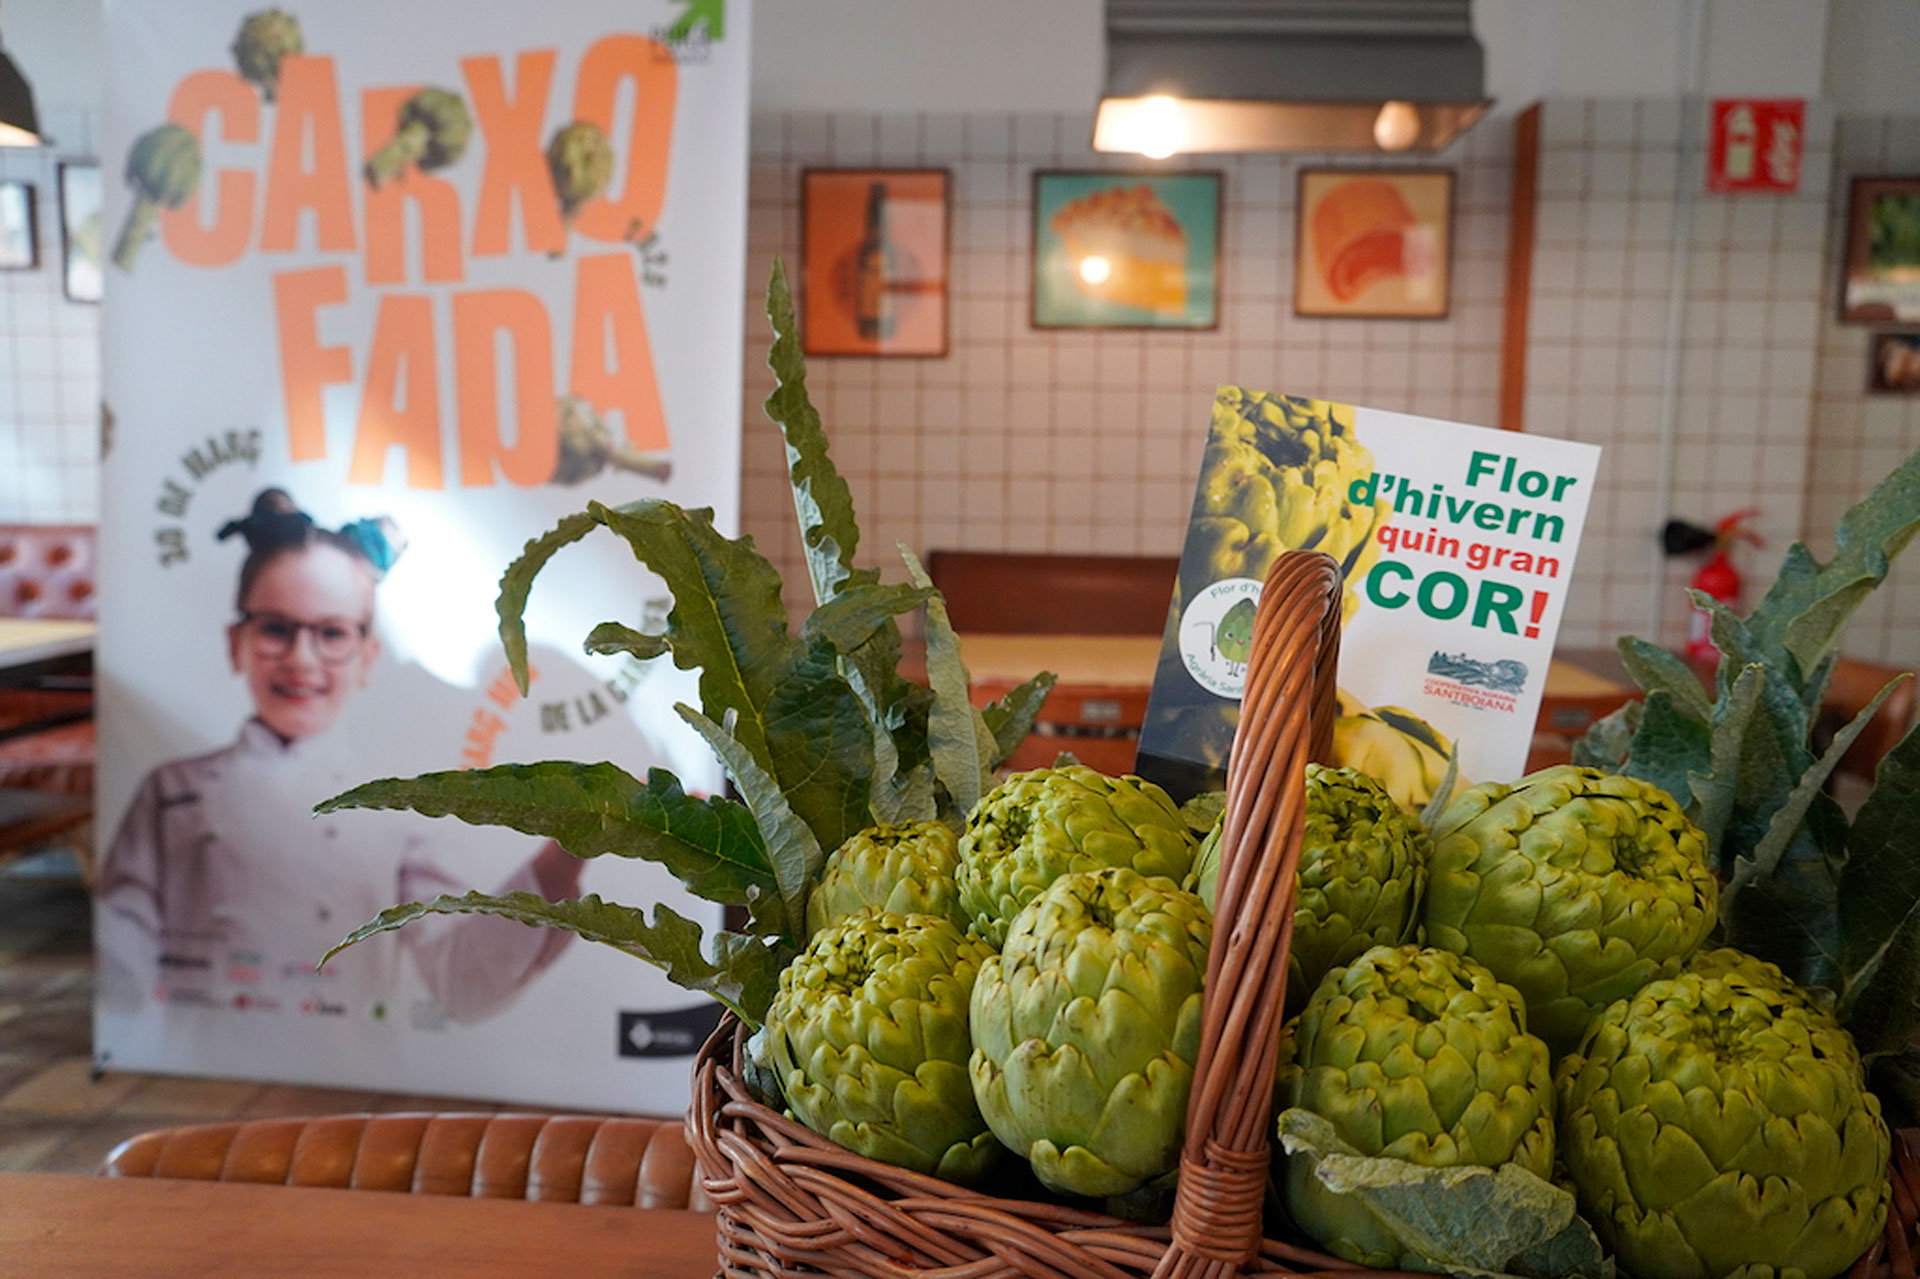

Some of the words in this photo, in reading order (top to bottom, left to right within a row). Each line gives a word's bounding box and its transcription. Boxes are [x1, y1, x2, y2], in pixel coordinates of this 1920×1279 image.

[160, 33, 680, 286] CARXO
[271, 251, 671, 491] FADA
[1465, 450, 1577, 503] Flor
[1376, 525, 1461, 559] quin
[1465, 542, 1560, 578] gran
[1210, 584, 1236, 599] Flor
[1365, 560, 1550, 640] COR!
[540, 702, 569, 734] DE
[574, 692, 609, 726] LA
[1423, 685, 1515, 713] SANTBOIANA
